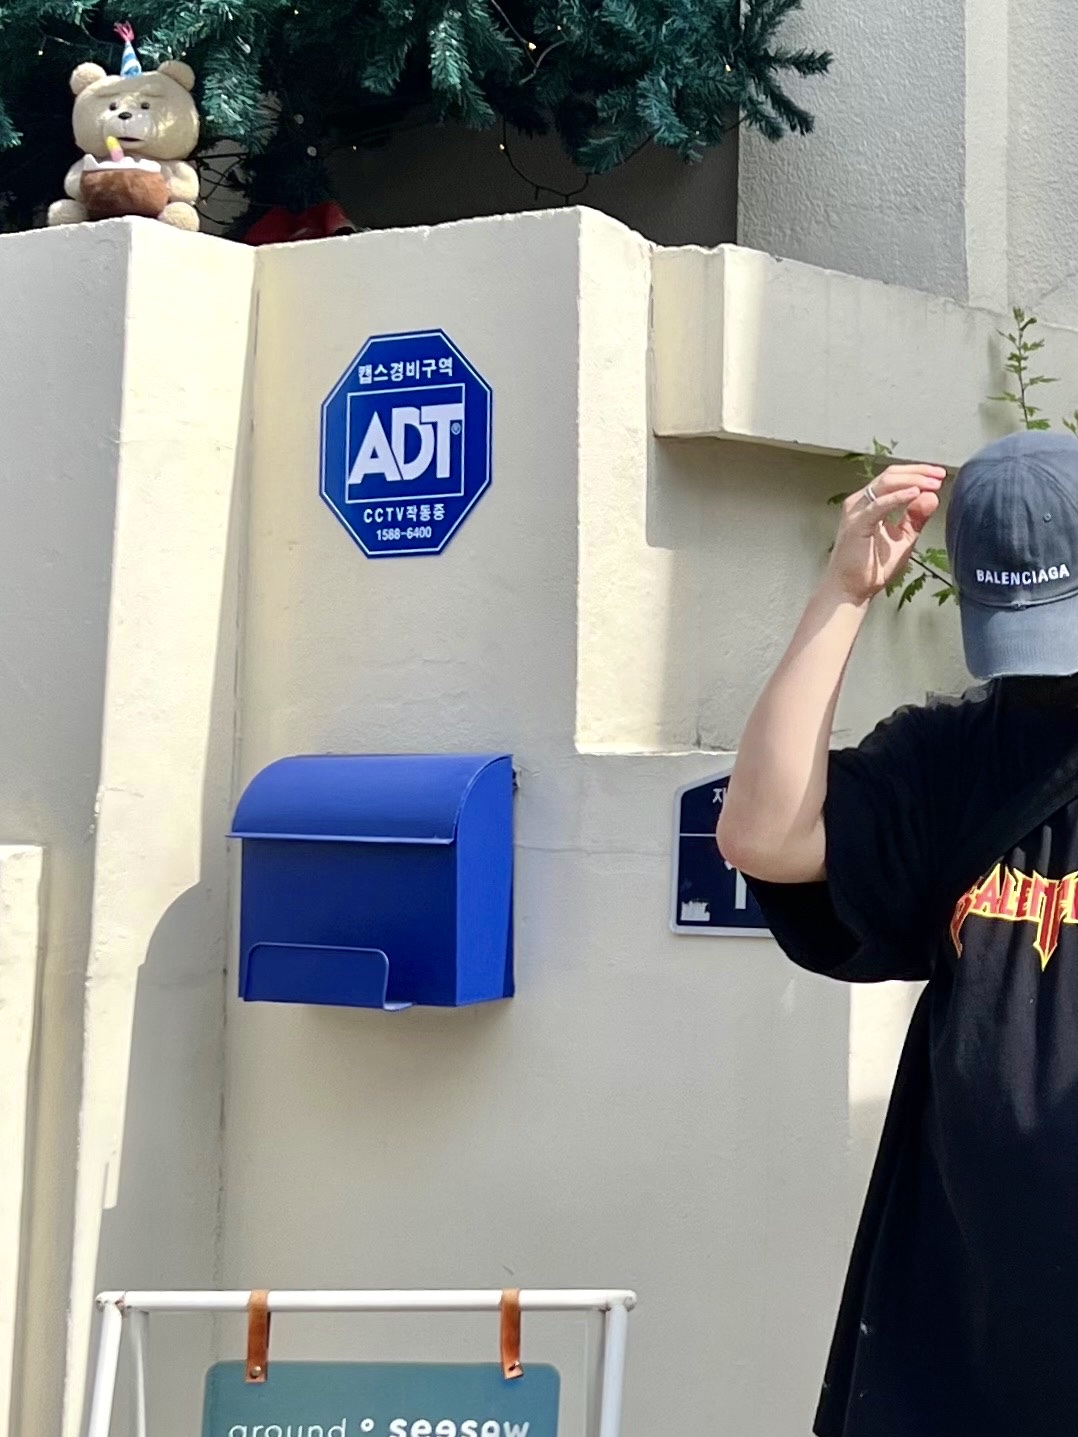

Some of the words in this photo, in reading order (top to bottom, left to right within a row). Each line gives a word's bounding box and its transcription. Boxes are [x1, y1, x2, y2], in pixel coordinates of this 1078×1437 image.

[358, 357, 453, 384] 캡스경비구역
[348, 403, 464, 484] ADT
[363, 504, 446, 523] CCTV작동중
[376, 526, 432, 541] 1588-6400
[976, 564, 1070, 585] BALENCIAGA
